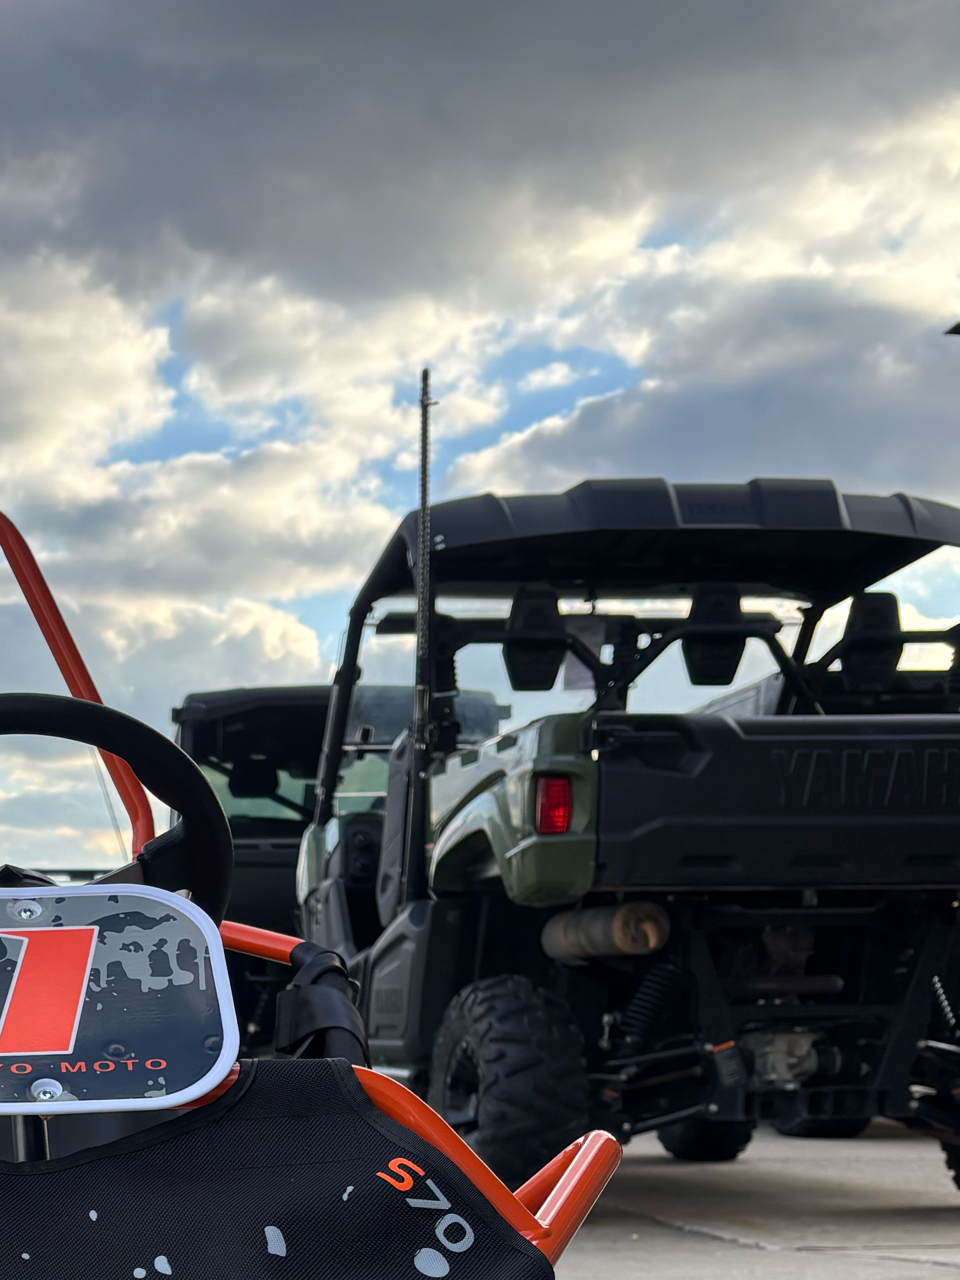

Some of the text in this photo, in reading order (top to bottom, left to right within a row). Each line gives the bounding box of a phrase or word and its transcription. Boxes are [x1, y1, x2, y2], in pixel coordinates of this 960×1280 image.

[771, 748, 960, 807] YAMAH
[60, 1058, 168, 1074] MOTO
[375, 1157, 475, 1253] S70
